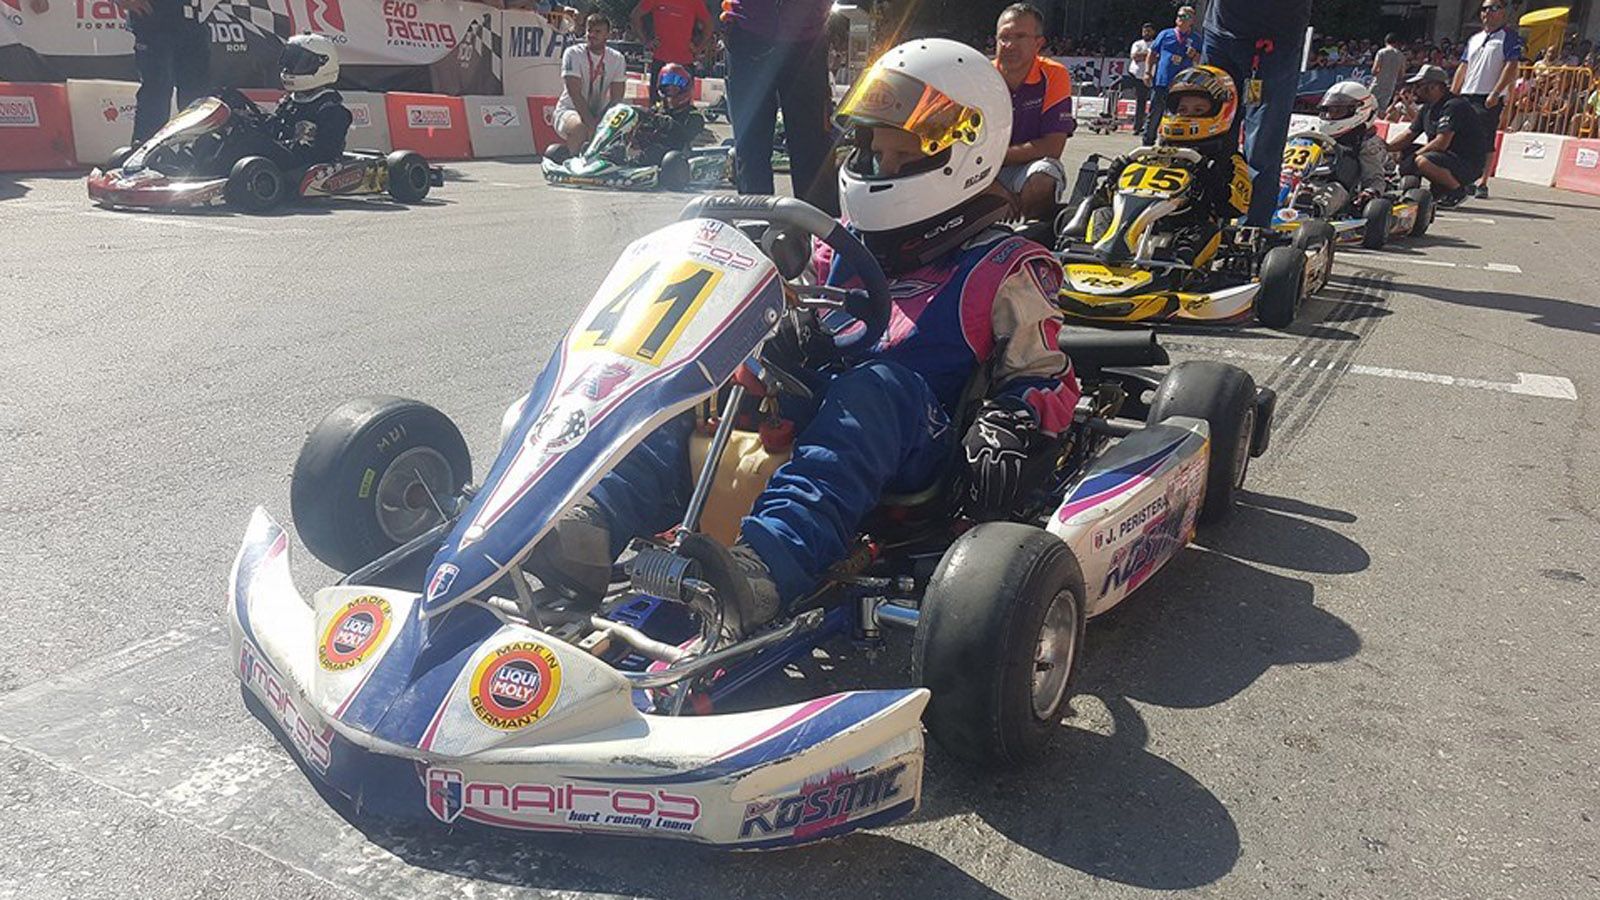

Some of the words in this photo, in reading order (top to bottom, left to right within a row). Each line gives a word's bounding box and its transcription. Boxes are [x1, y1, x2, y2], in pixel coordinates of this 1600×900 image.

[383, 0, 418, 19] EKO
[208, 23, 245, 43] 100
[385, 18, 457, 49] racing
[226, 44, 248, 52] RON
[1282, 148, 1311, 165] 23
[1122, 166, 1186, 191] 15
[584, 259, 716, 360] 41
[1105, 527, 1117, 545] J.
[342, 617, 373, 637] LIQUI
[318, 644, 364, 672] GERMANY
[495, 642, 545, 657] MADE
[545, 653, 559, 670] IN
[498, 667, 539, 687] LIQUI
[493, 680, 533, 699] MOLY
[471, 694, 541, 729] GERMANY
[568, 810, 600, 823] kart
[604, 814, 652, 829] racing
[655, 817, 693, 832] team
